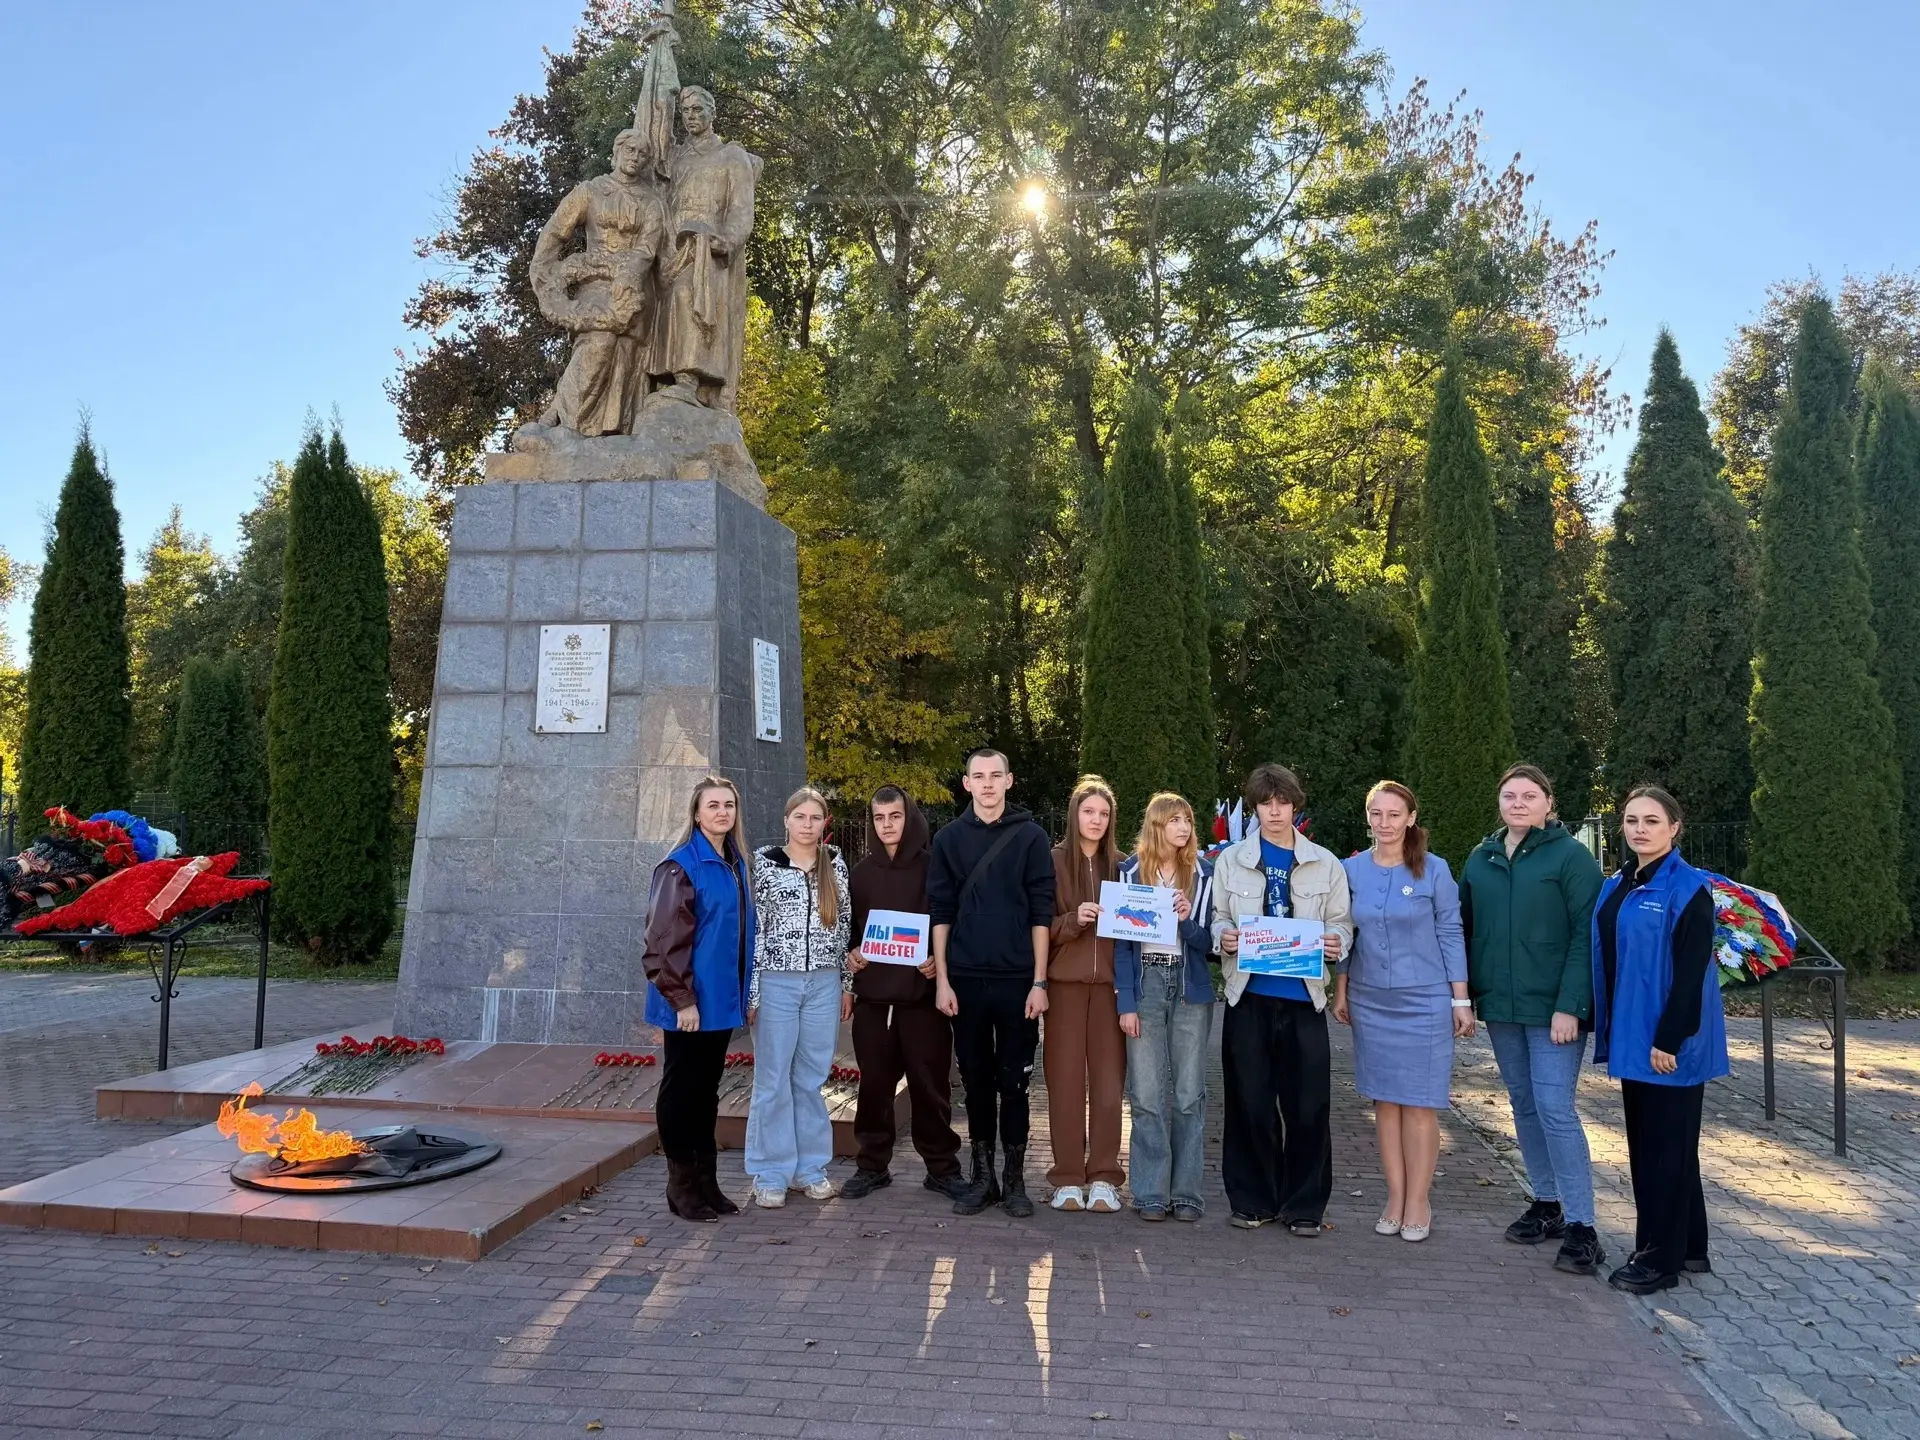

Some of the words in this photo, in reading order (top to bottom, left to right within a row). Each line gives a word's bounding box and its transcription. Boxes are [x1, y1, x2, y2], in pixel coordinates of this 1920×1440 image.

[866, 924, 890, 940] МЫ
[1244, 929, 1272, 938] ВМЕСТЕ
[1245, 935, 1287, 944] НАВСЕГДА!
[862, 941, 915, 958] ВМЕСТЕ!
